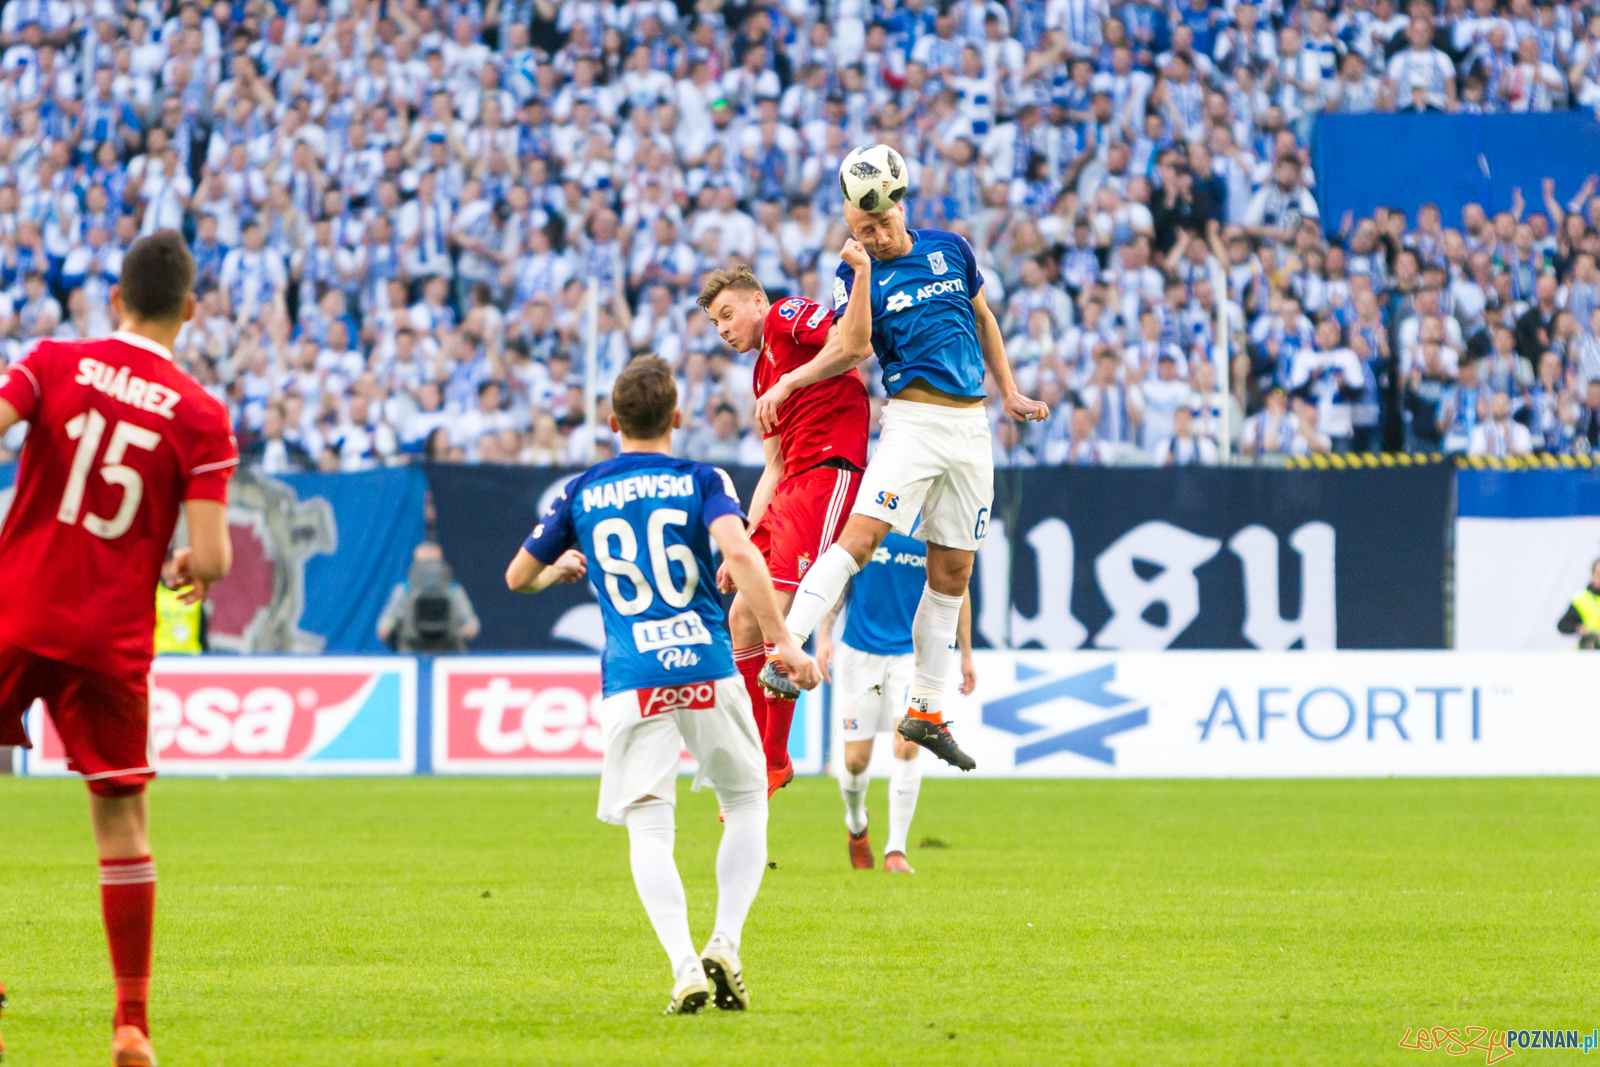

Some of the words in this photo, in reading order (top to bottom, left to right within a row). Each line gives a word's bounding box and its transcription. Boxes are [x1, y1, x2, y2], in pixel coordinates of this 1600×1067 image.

[916, 278, 965, 302] AFORTI
[779, 298, 805, 320] STS
[75, 357, 182, 420] SUÁREZ
[57, 408, 162, 540] 15
[582, 474, 695, 513] MAJEWSKI
[875, 490, 899, 510] STS
[592, 508, 699, 616] 86
[894, 552, 927, 568] AFOR
[642, 618, 702, 642] LECH
[656, 647, 701, 671] Pils
[643, 684, 713, 716] fogo
[843, 717, 858, 730] STS
[1196, 686, 1482, 742] AFORTI
